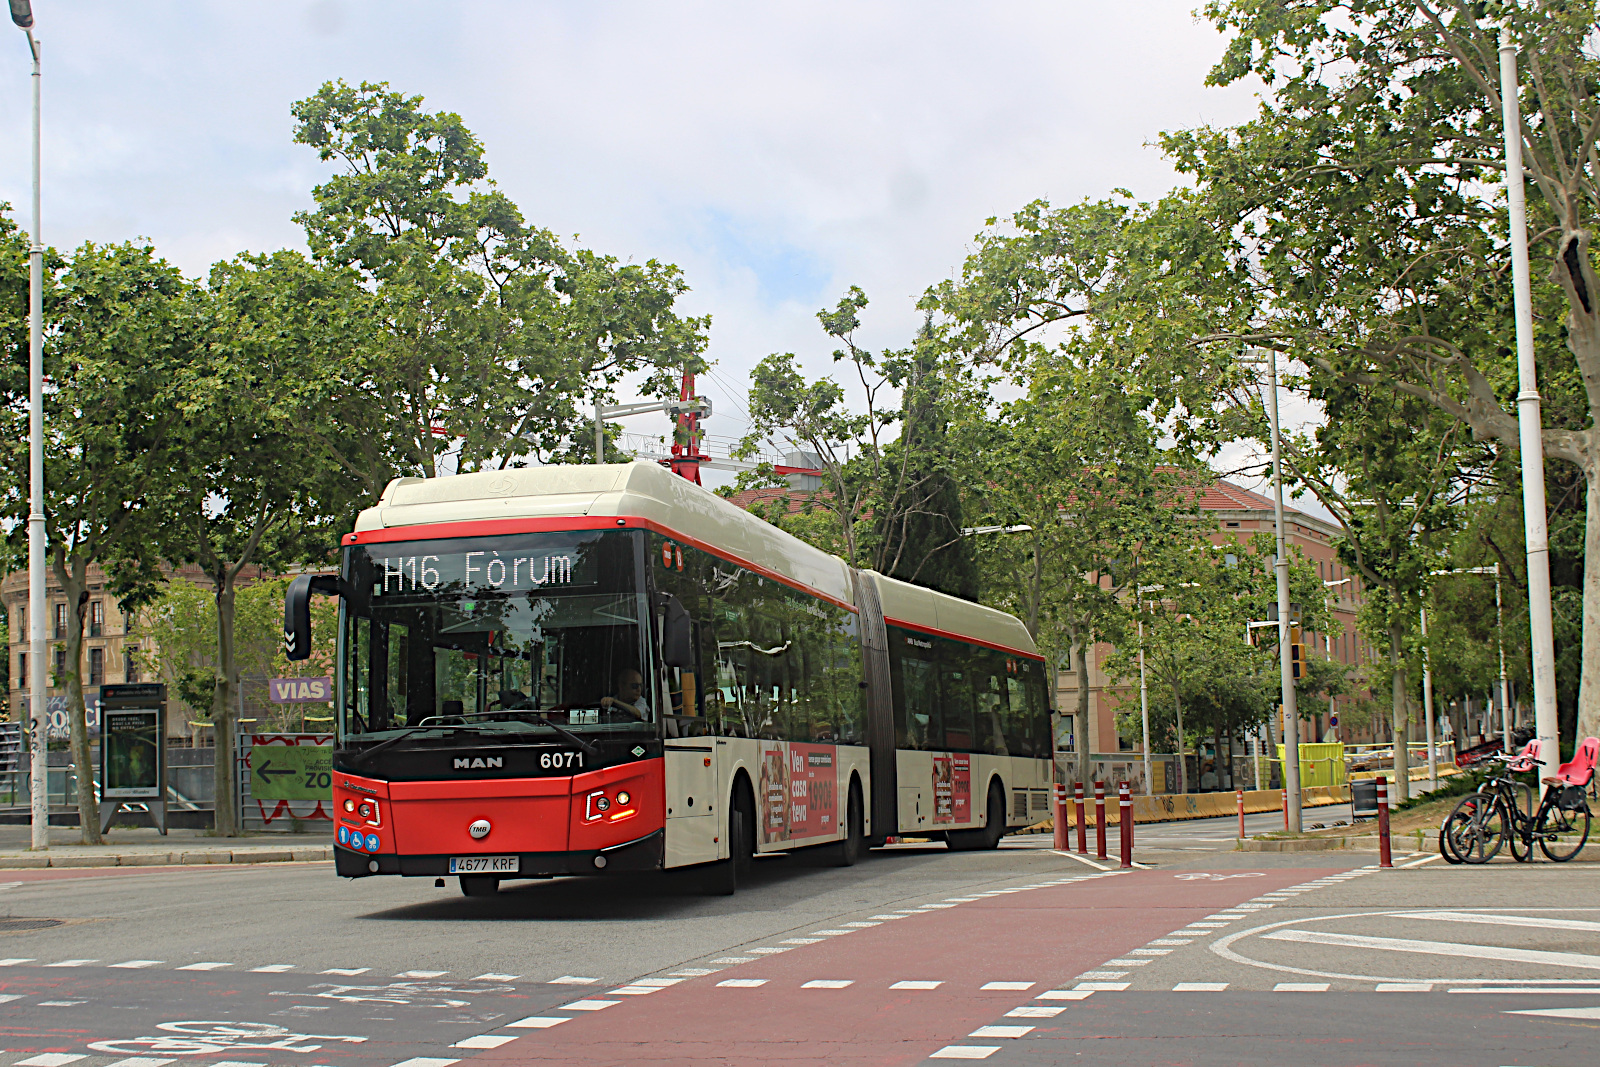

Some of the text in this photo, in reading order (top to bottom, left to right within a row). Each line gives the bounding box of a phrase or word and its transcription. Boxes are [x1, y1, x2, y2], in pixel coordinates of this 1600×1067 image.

[384, 551, 571, 591] H16 Fòrum
[276, 681, 325, 700] VIAS
[454, 757, 503, 769] MAN
[540, 752, 583, 769] 6071
[791, 750, 804, 772] Ven
[305, 772, 332, 788] ZO
[792, 780, 807, 798] casa
[792, 801, 807, 822] teva
[458, 858, 488, 870] 4677
[492, 858, 516, 870] KRF
